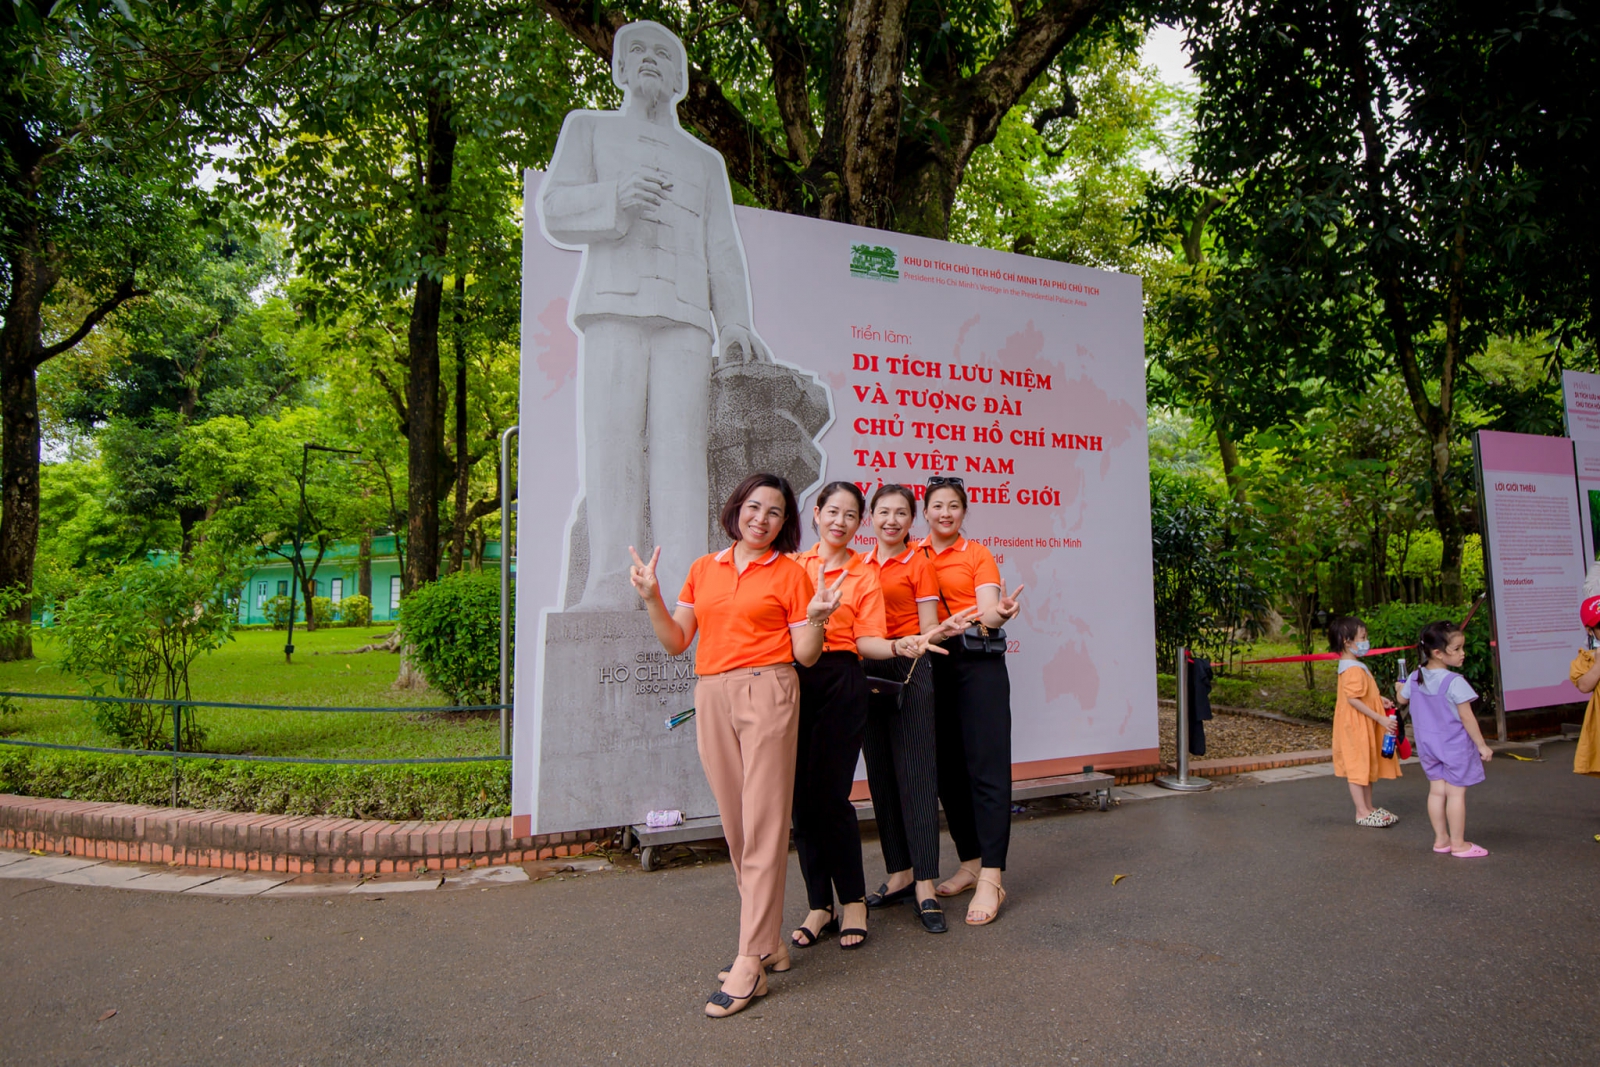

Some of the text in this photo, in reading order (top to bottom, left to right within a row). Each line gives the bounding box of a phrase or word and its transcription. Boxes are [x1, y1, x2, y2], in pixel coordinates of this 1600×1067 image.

[904, 256, 921, 266] KHU
[924, 259, 932, 268] DI
[934, 260, 952, 271] TÍCH
[953, 264, 970, 274] CHỦ
[972, 267, 989, 277] TỊCH
[1003, 272, 1015, 281] CHÍ
[1017, 275, 1037, 285] MINH
[1084, 286, 1100, 296] TỊCH
[904, 272, 934, 283] President
[936, 277, 945, 285] Ho
[947, 278, 957, 286] Chi
[980, 284, 1002, 294] Vestige
[1010, 288, 1020, 296] the
[1021, 290, 1054, 301] Presidential
[1056, 296, 1073, 305] Palace
[851, 325, 881, 341] Triển
[852, 354, 1052, 392] DI TÍCH LƯU NIỆM
[852, 382, 1022, 416] VÀ TƯỢNG ĐÀI
[853, 413, 1103, 451] CHỦ TỊCH HỒ CHÍ MINH
[854, 450, 1015, 475] TẠI VIỆT NAM
[967, 481, 1011, 504] THẾ
[1017, 486, 1061, 506] GIỚI
[1495, 482, 1536, 492] LỜI GIỚI THIỆU
[983, 538, 991, 546] of
[994, 538, 1033, 547] President
[1036, 538, 1047, 547] Ho
[1049, 538, 1061, 547] Chi
[1063, 538, 1082, 548] Minh
[599, 663, 630, 683] HỒ
[634, 662, 668, 681] CHÍ
[635, 683, 690, 695] 1890-1969
